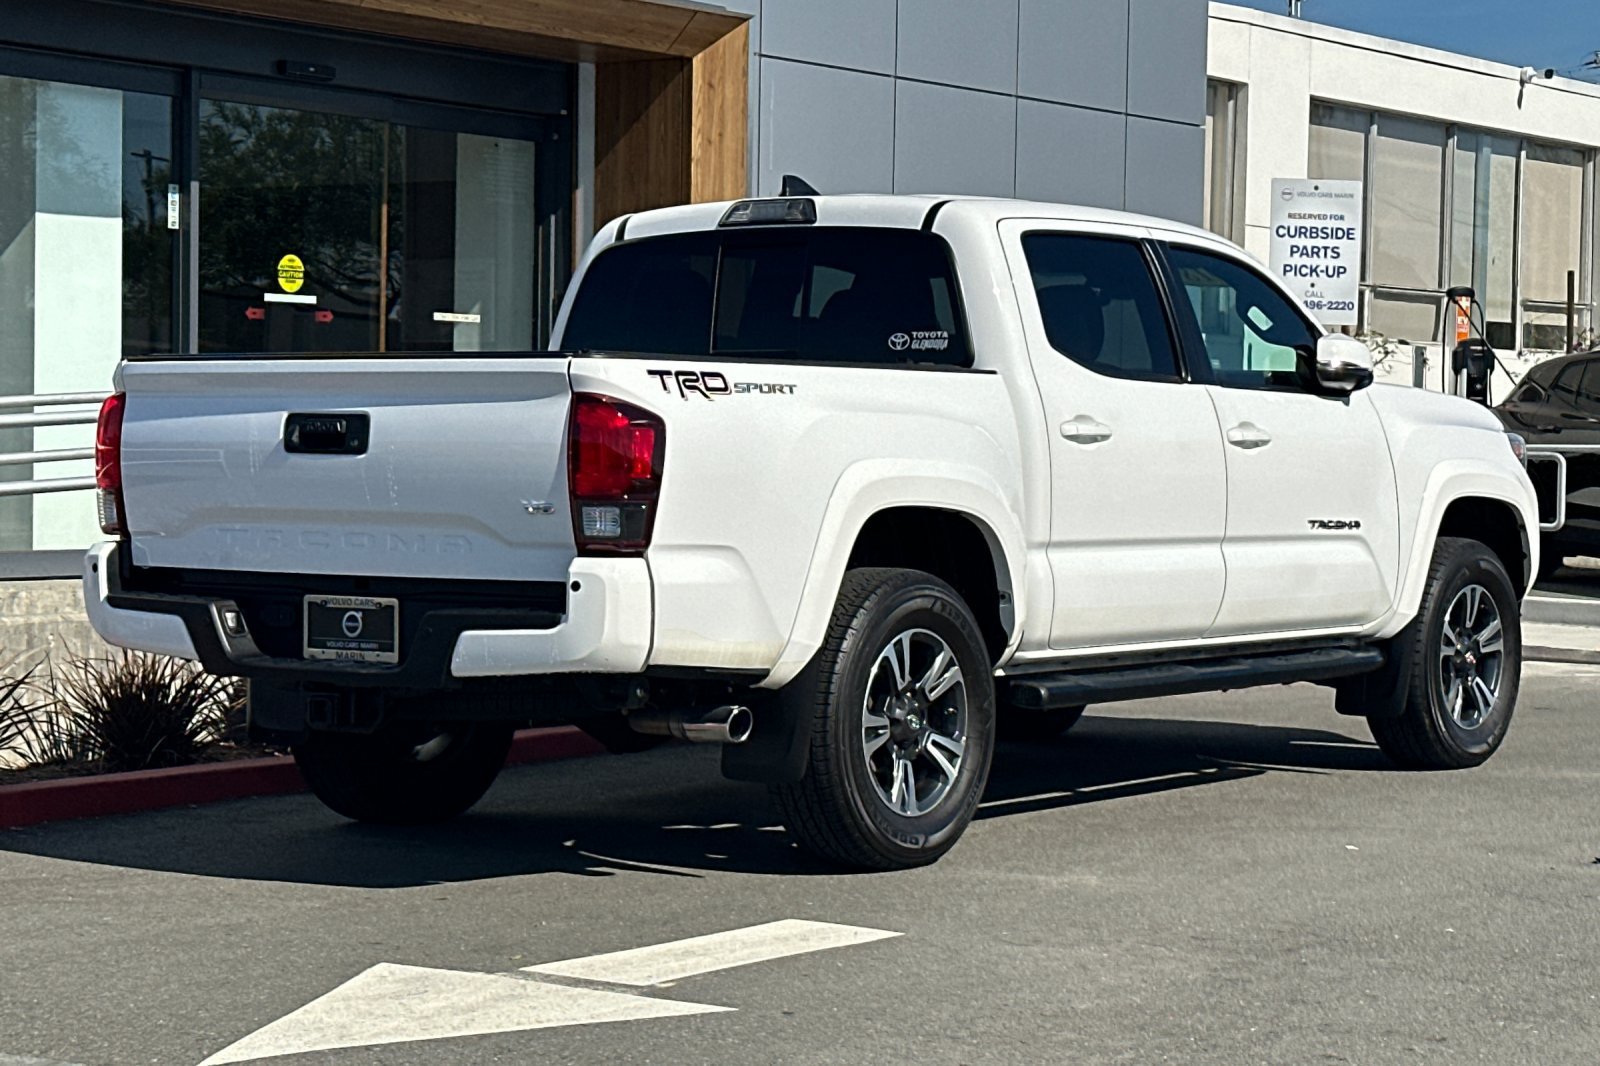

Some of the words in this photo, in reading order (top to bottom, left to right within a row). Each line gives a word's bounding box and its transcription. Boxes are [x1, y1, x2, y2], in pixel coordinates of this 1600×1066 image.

[1288, 212, 1328, 221] RESERVED
[1329, 213, 1345, 221] FOR
[1275, 225, 1356, 240] CURBSIDE
[1289, 244, 1340, 259] PARTS
[1283, 264, 1347, 278] PICK-UP
[1304, 290, 1324, 298] CALL
[911, 331, 949, 339] TOYOTA
[646, 369, 732, 401] TRD
[734, 382, 798, 395] SPORT
[1307, 519, 1361, 530] TACOMA
[215, 527, 474, 553] TACOMA
[326, 597, 352, 606] VOLVO
[354, 598, 376, 607] CARS
[335, 651, 366, 660] MARIN
